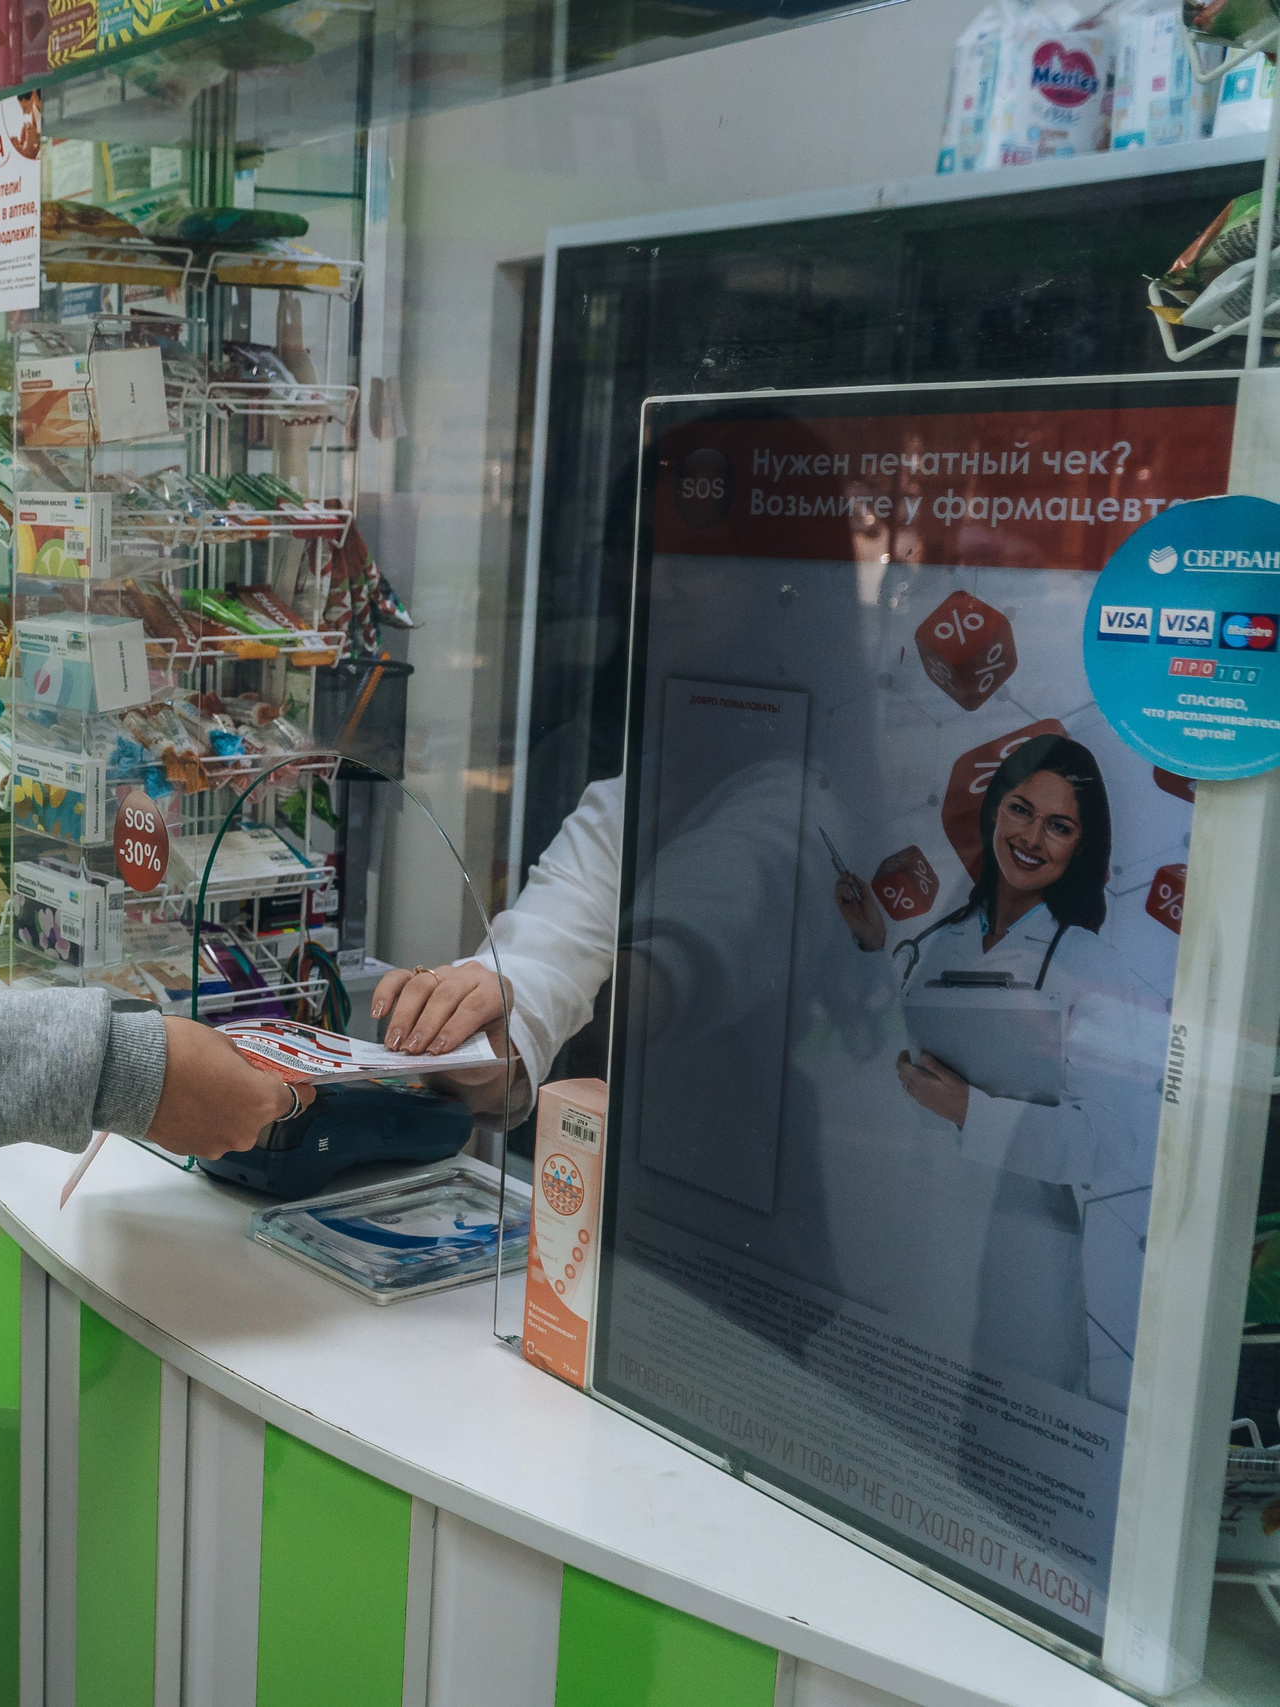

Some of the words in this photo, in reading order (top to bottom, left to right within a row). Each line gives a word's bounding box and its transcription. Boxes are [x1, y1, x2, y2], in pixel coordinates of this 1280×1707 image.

[100, 19, 109, 34] 12
[51, 36, 60, 51] 12
[2, 207, 7, 220] в
[9, 201, 38, 219] аптеке,
[753, 447, 849, 482] Нужен
[861, 441, 1030, 475] печатный
[1042, 441, 1133, 476] чек?
[681, 477, 725, 499] SOS
[750, 488, 892, 518] Возьмите
[904, 494, 923, 525] у
[1104, 610, 1148, 629] VISA
[1165, 614, 1210, 633] VISA
[1227, 624, 1273, 638] Maestro
[689, 695, 718, 706] ДОБРО
[1143, 706, 1165, 719] что
[1177, 693, 1248, 711] СПАСИБО,
[1183, 727, 1236, 741] картой!
[125, 807, 155, 833] SOS
[120, 838, 161, 872] -30%
[1165, 1023, 1187, 1105] PHILIPS
[528, 1309, 577, 1340] Восстанавливает
[529, 1300, 559, 1321] Увлажняет
[528, 1318, 548, 1335] Питает
[839, 1312, 881, 1339] возврату
[891, 1333, 932, 1361] обмену
[934, 1353, 948, 1365] не
[950, 1359, 1005, 1391] подлежит.
[563, 1362, 570, 1371] 75
[570, 1368, 579, 1376] мл
[839, 1326, 888, 1355] редакции
[1010, 1398, 1022, 1413] от
[1024, 1404, 1069, 1433] 22.11.04
[852, 1370, 866, 1385] РФ
[869, 1379, 880, 1392] от
[882, 1383, 935, 1417] 31.12.2020
[938, 1409, 950, 1424] №
[952, 1415, 977, 1436] 2463
[855, 1346, 923, 1384] запрещается
[925, 1377, 983, 1410] принимать
[986, 1403, 998, 1416] от
[1000, 1408, 1069, 1449] физических
[1071, 1441, 1094, 1459] лиц
[835, 1377, 881, 1408] договору
[884, 1398, 940, 1434] розничной
[1035, 1469, 1085, 1502] перечня
[838, 1392, 936, 1447] распространяется
[938, 1437, 1006, 1479] требование
[1008, 1470, 1084, 1517] потребителя
[842, 1421, 888, 1452] ремонта
[891, 1445, 909, 1461] или
[911, 1454, 954, 1483] замены
[956, 1476, 993, 1502] такого
[618, 1349, 714, 1425] ПРОВЕРЯЙТЕ
[718, 1402, 778, 1459] СДАЧУ
[781, 1434, 794, 1465] И
[797, 1441, 858, 1499] ТОВАР
[862, 1474, 887, 1513] НЕ
[890, 1488, 974, 1560] ОТХОДЯ
[979, 1533, 1008, 1575] ОТ
[1011, 1549, 1092, 1619] КАССЫ
[907, 1477, 974, 1521] Российской
[933, 1451, 967, 1475] этими
[969, 1468, 986, 1484] же
[988, 1477, 1057, 1517] основными
[906, 1466, 919, 1480] не
[1060, 1540, 1097, 1567] также
